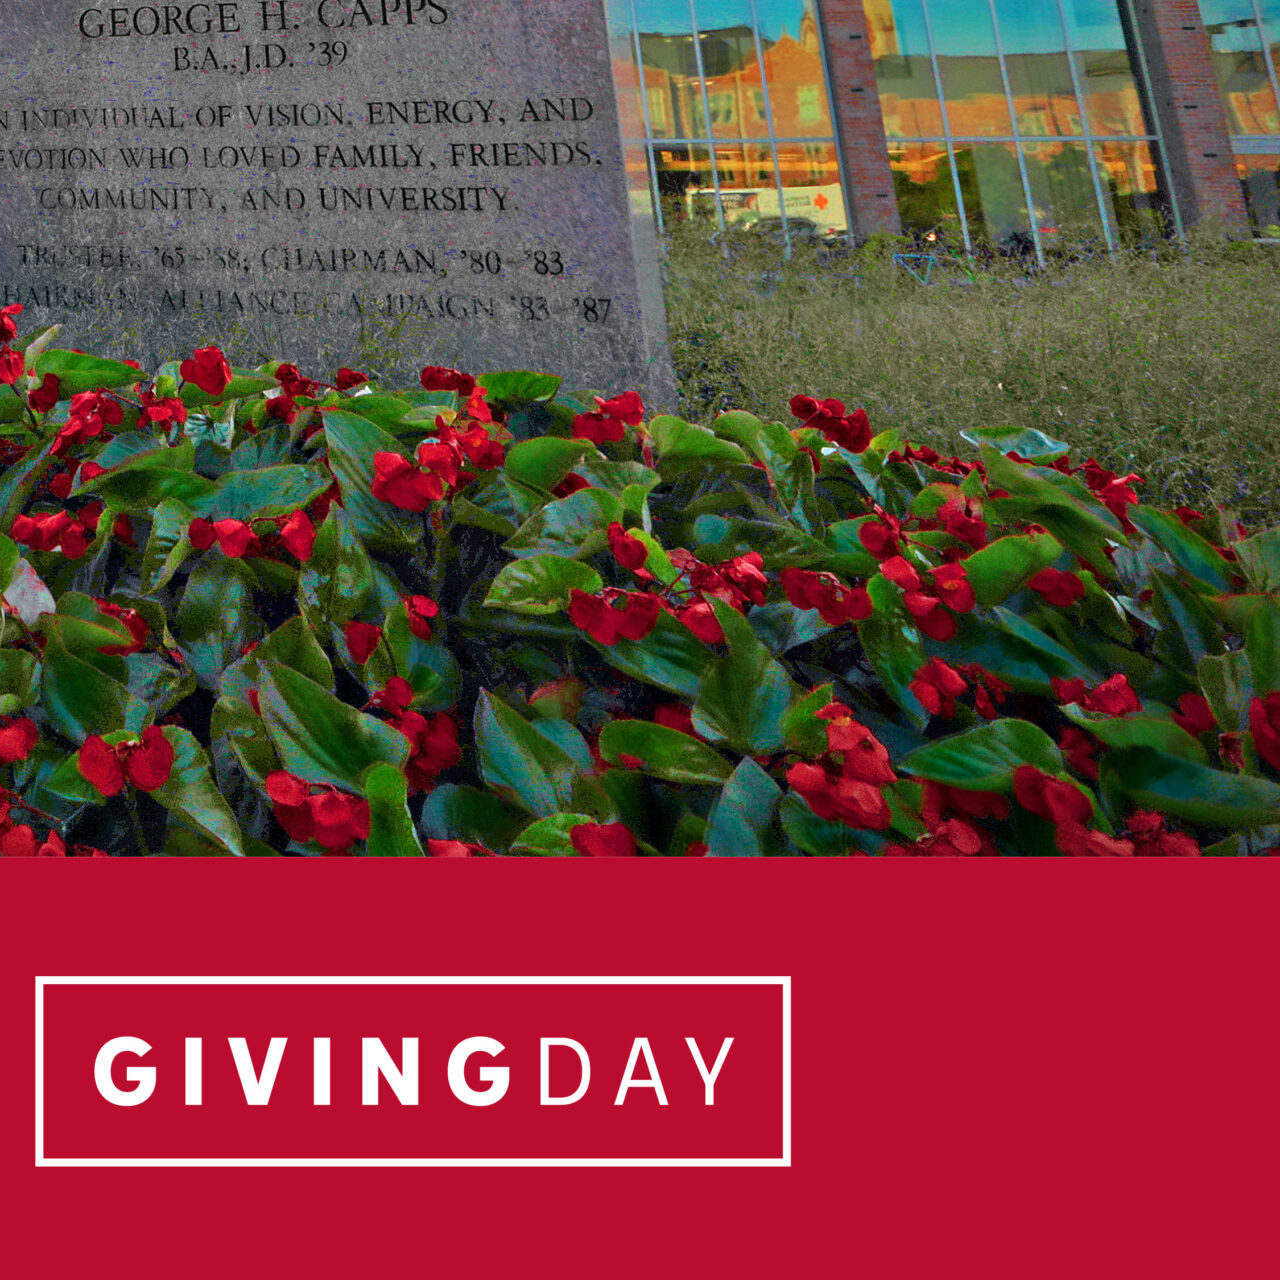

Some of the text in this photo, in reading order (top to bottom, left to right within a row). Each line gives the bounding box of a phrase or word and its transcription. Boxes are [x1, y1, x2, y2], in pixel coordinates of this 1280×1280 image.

[78, 2, 241, 38] GEORGE
[257, 0, 299, 32] H.
[308, 40, 348, 67] '39
[21, 106, 184, 132] INDIVIDUAL
[195, 105, 233, 128] OF
[366, 99, 506, 125] ENERGY,
[519, 97, 594, 122] AND
[120, 146, 189, 169] WHO
[202, 145, 300, 169] LOVED
[314, 144, 436, 171] FAMILY,
[449, 141, 603, 167] FRIENDS,
[39, 186, 520, 214] COMMUNITY, AND UNIVERSITY.
[261, 247, 447, 278] CHAIRMAN,
